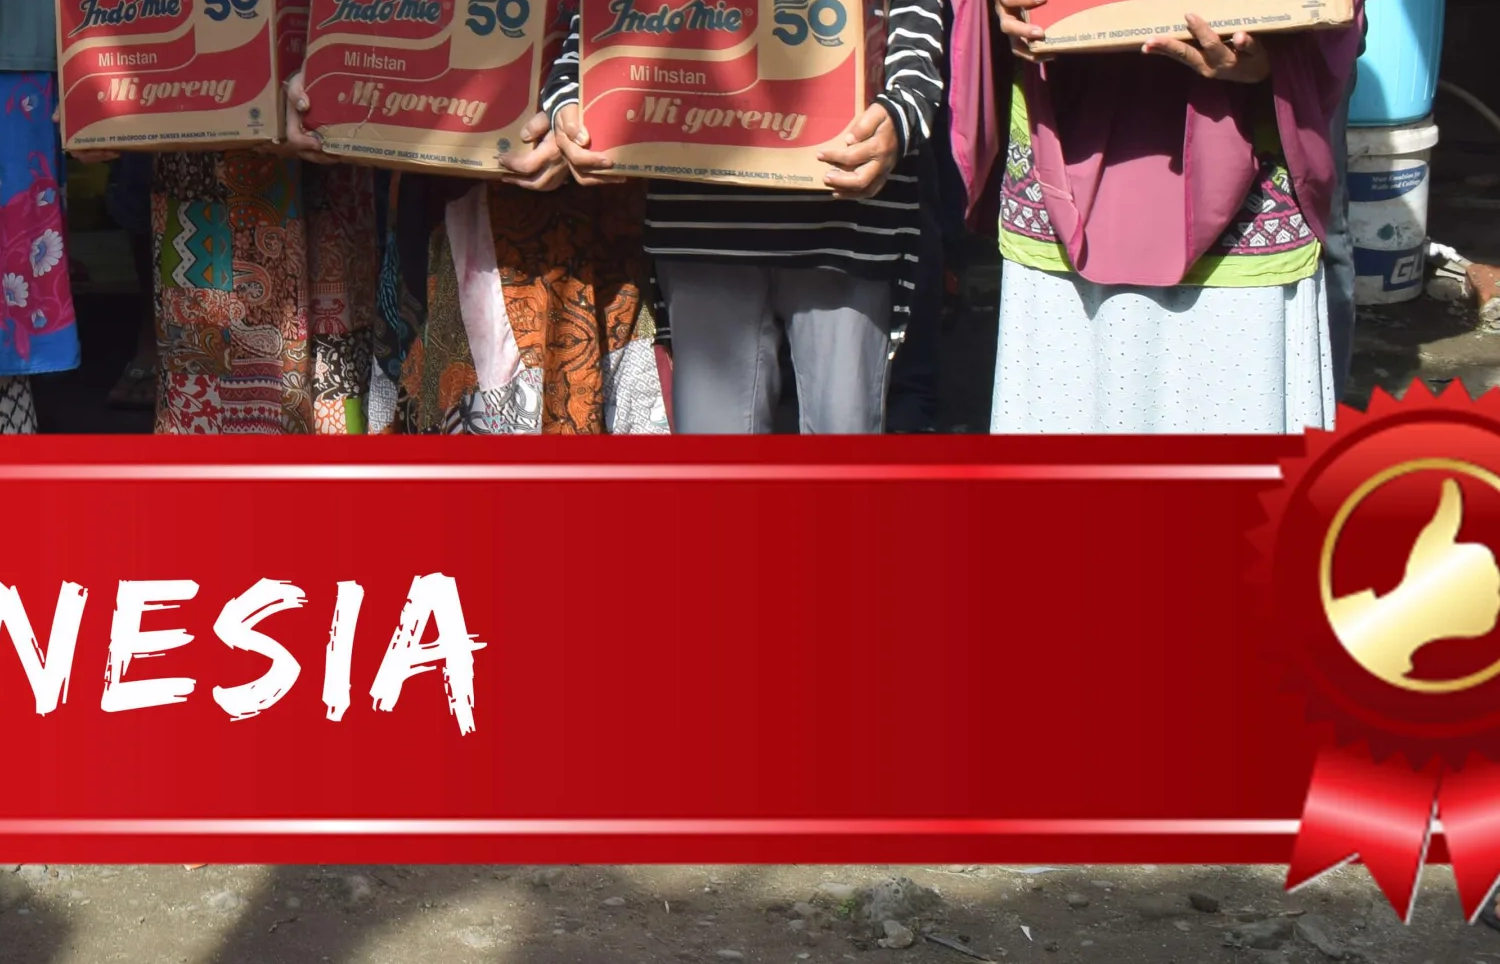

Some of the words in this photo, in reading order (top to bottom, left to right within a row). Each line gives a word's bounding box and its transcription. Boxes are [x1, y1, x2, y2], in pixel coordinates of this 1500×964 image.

[98, 53, 114, 67] Mi
[116, 51, 157, 65] Instan
[344, 51, 361, 66] Mi
[363, 53, 406, 71] Instan
[630, 65, 650, 81] Mi
[654, 66, 706, 85] Instan
[97, 77, 139, 102] Mi
[139, 78, 236, 106] goreng
[338, 80, 384, 108] Mi
[382, 87, 488, 126] goreng
[626, 96, 682, 124] Mi
[682, 107, 807, 140] goreng
